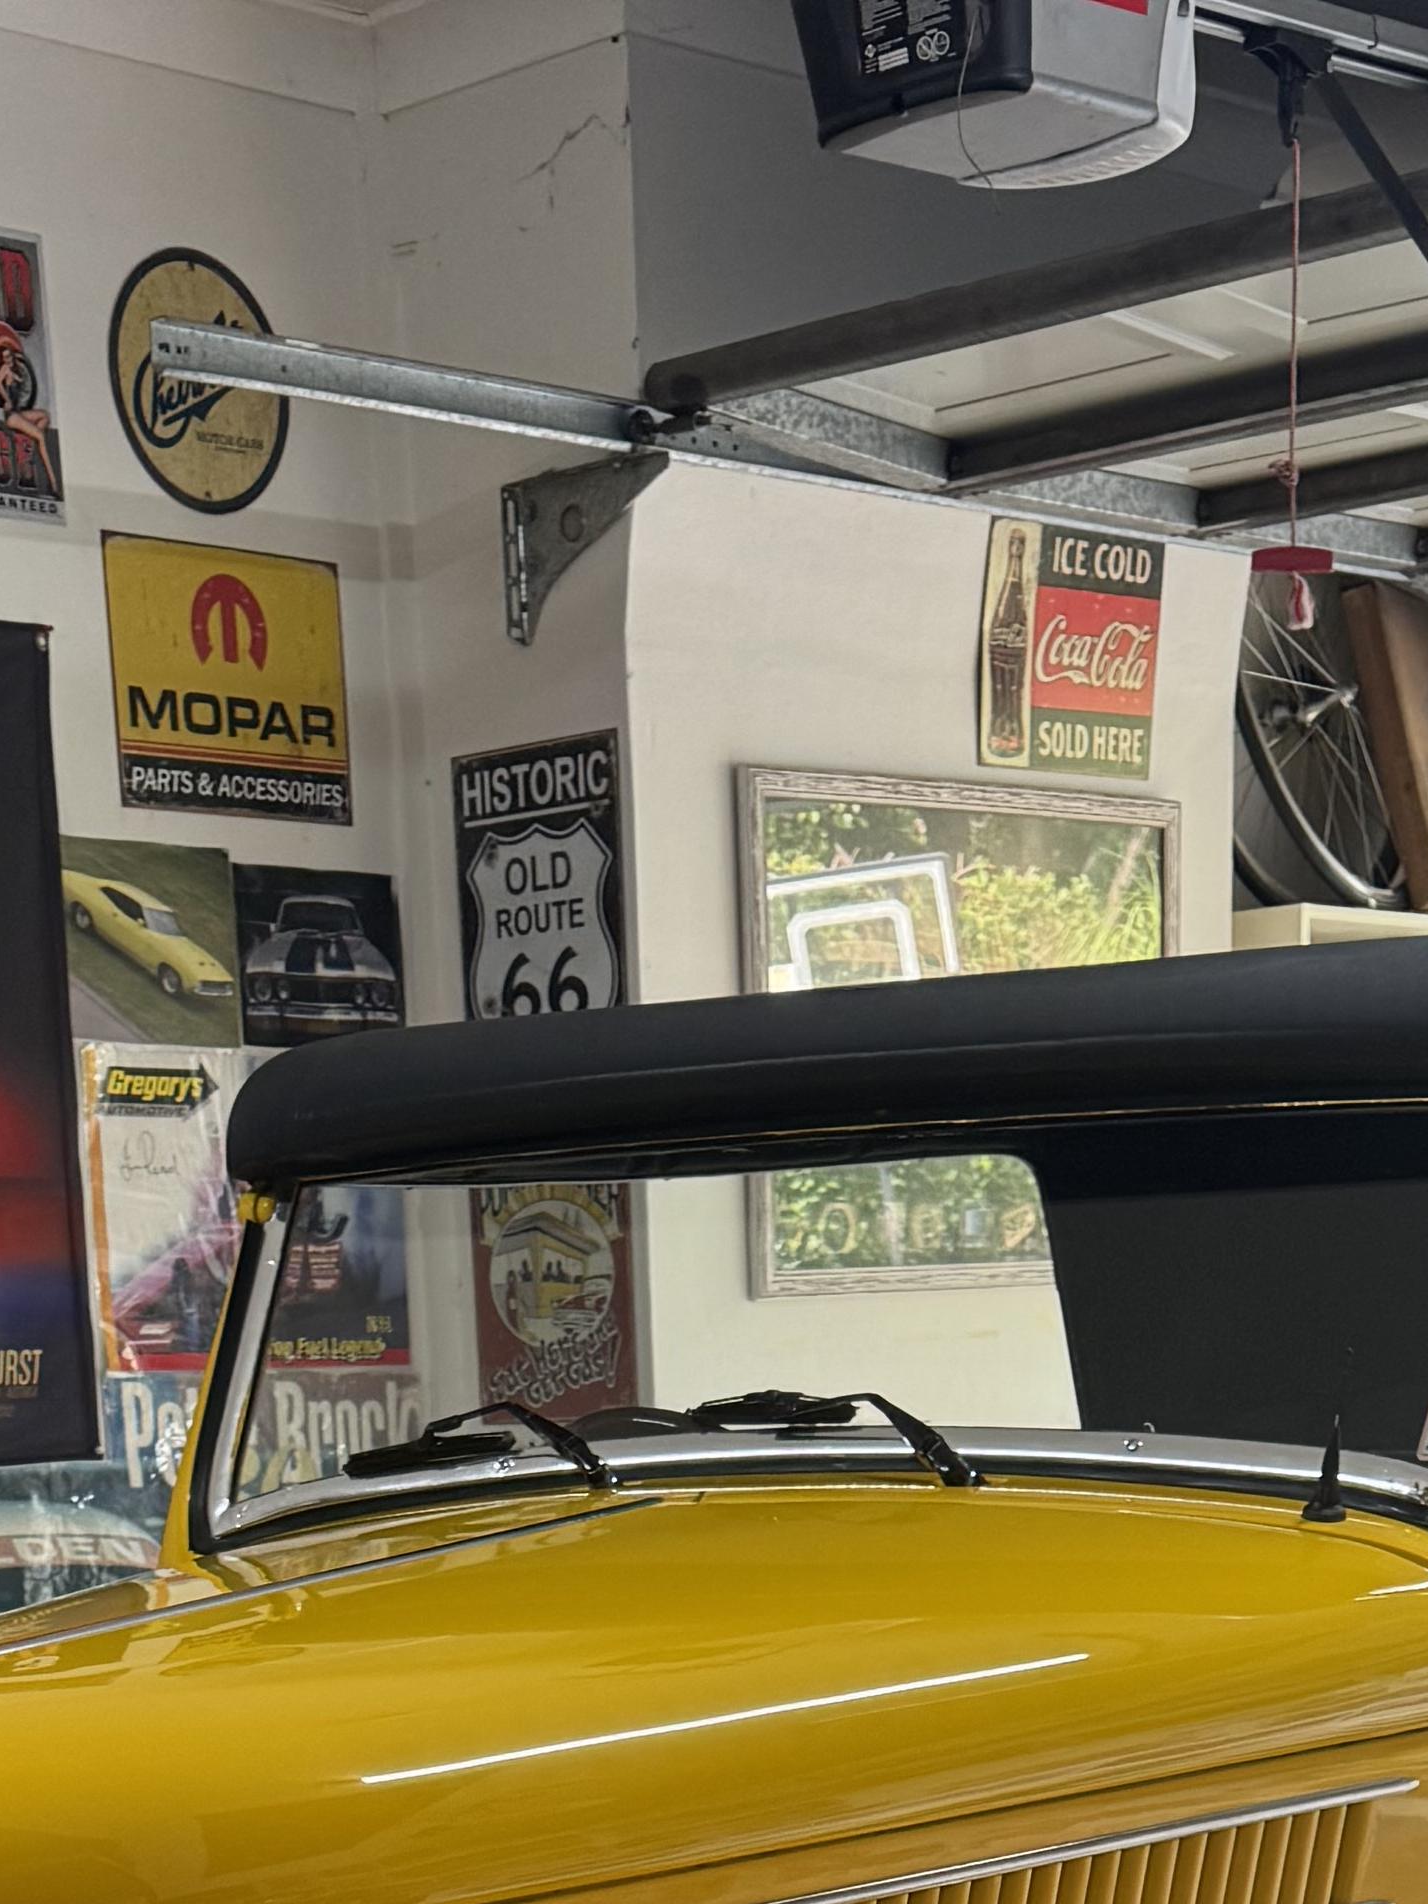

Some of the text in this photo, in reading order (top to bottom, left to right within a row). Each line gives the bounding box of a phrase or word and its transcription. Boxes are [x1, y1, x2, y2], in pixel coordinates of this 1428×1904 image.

[1053, 536, 1152, 584] ICE COLD
[128, 685, 336, 748] MOPAR
[1038, 721, 1145, 763] SOLD HERE
[132, 766, 343, 807] PARTS & ACCESSORIES
[462, 750, 609, 817] HISTORIC
[505, 851, 571, 895] OLD
[496, 898, 584, 938] ROUTE
[502, 946, 589, 1017] 66
[107, 1069, 204, 1103] Gregory's
